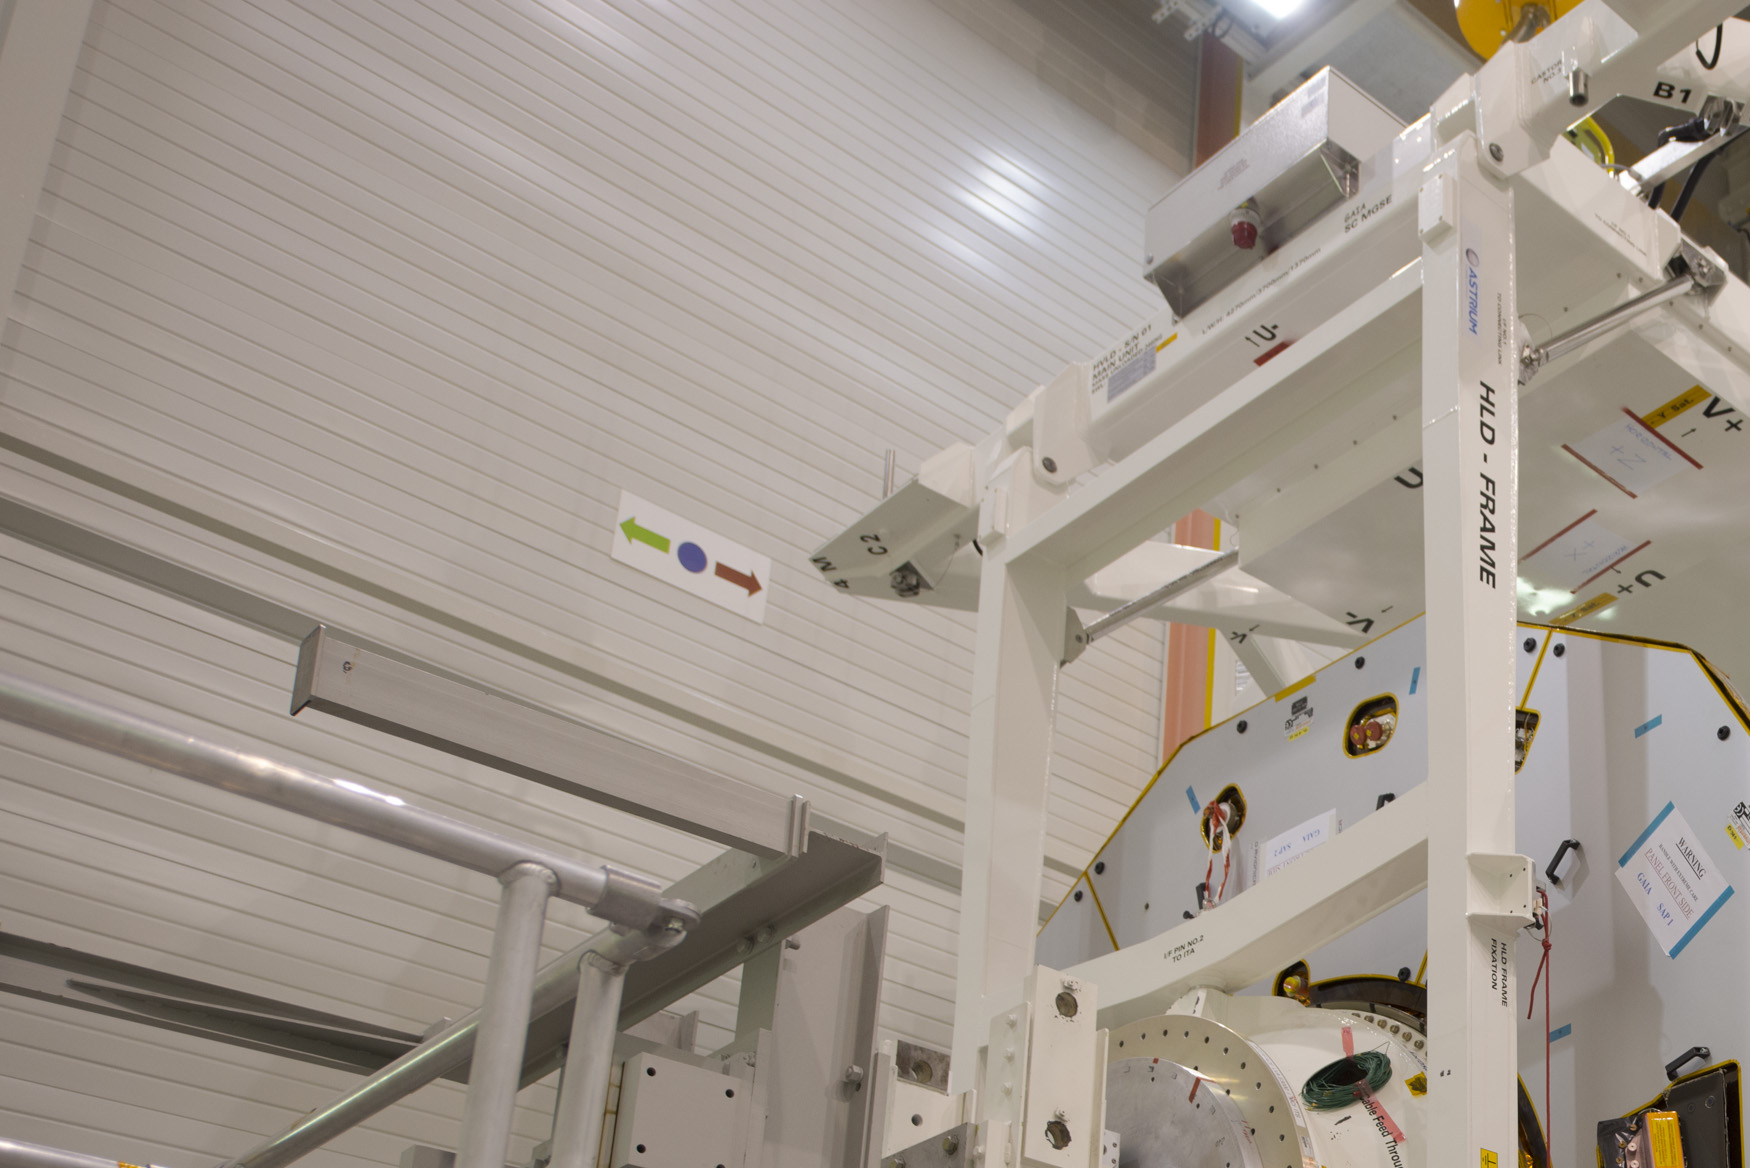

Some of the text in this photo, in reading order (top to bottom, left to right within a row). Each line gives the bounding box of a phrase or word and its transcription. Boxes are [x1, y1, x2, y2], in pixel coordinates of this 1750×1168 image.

[1652, 81, 1692, 104] B1
[1344, 202, 1366, 223] GAIA
[1344, 194, 1392, 233] SC MGSE
[1468, 266, 1478, 335] ASTRIUM
[1092, 359, 1116, 381] MAIN
[1119, 342, 1140, 362] UNIT
[1702, 395, 1744, 432] V+
[1479, 380, 1496, 589] HLD - FRAME
[859, 533, 888, 556] C2
[1617, 569, 1666, 594] U+
[1302, 828, 1320, 842] GAIA
[1678, 836, 1707, 878] WARNING
[1637, 872, 1674, 926] GAIA SAP 1
[1645, 848, 1695, 918] PANEL FRONT SIDE
[1172, 947, 1195, 964] TO ITA
[1174, 943, 1186, 954] PIN
[1490, 937, 1498, 990] FIXATION
[1372, 1114, 1393, 1138] Feed
